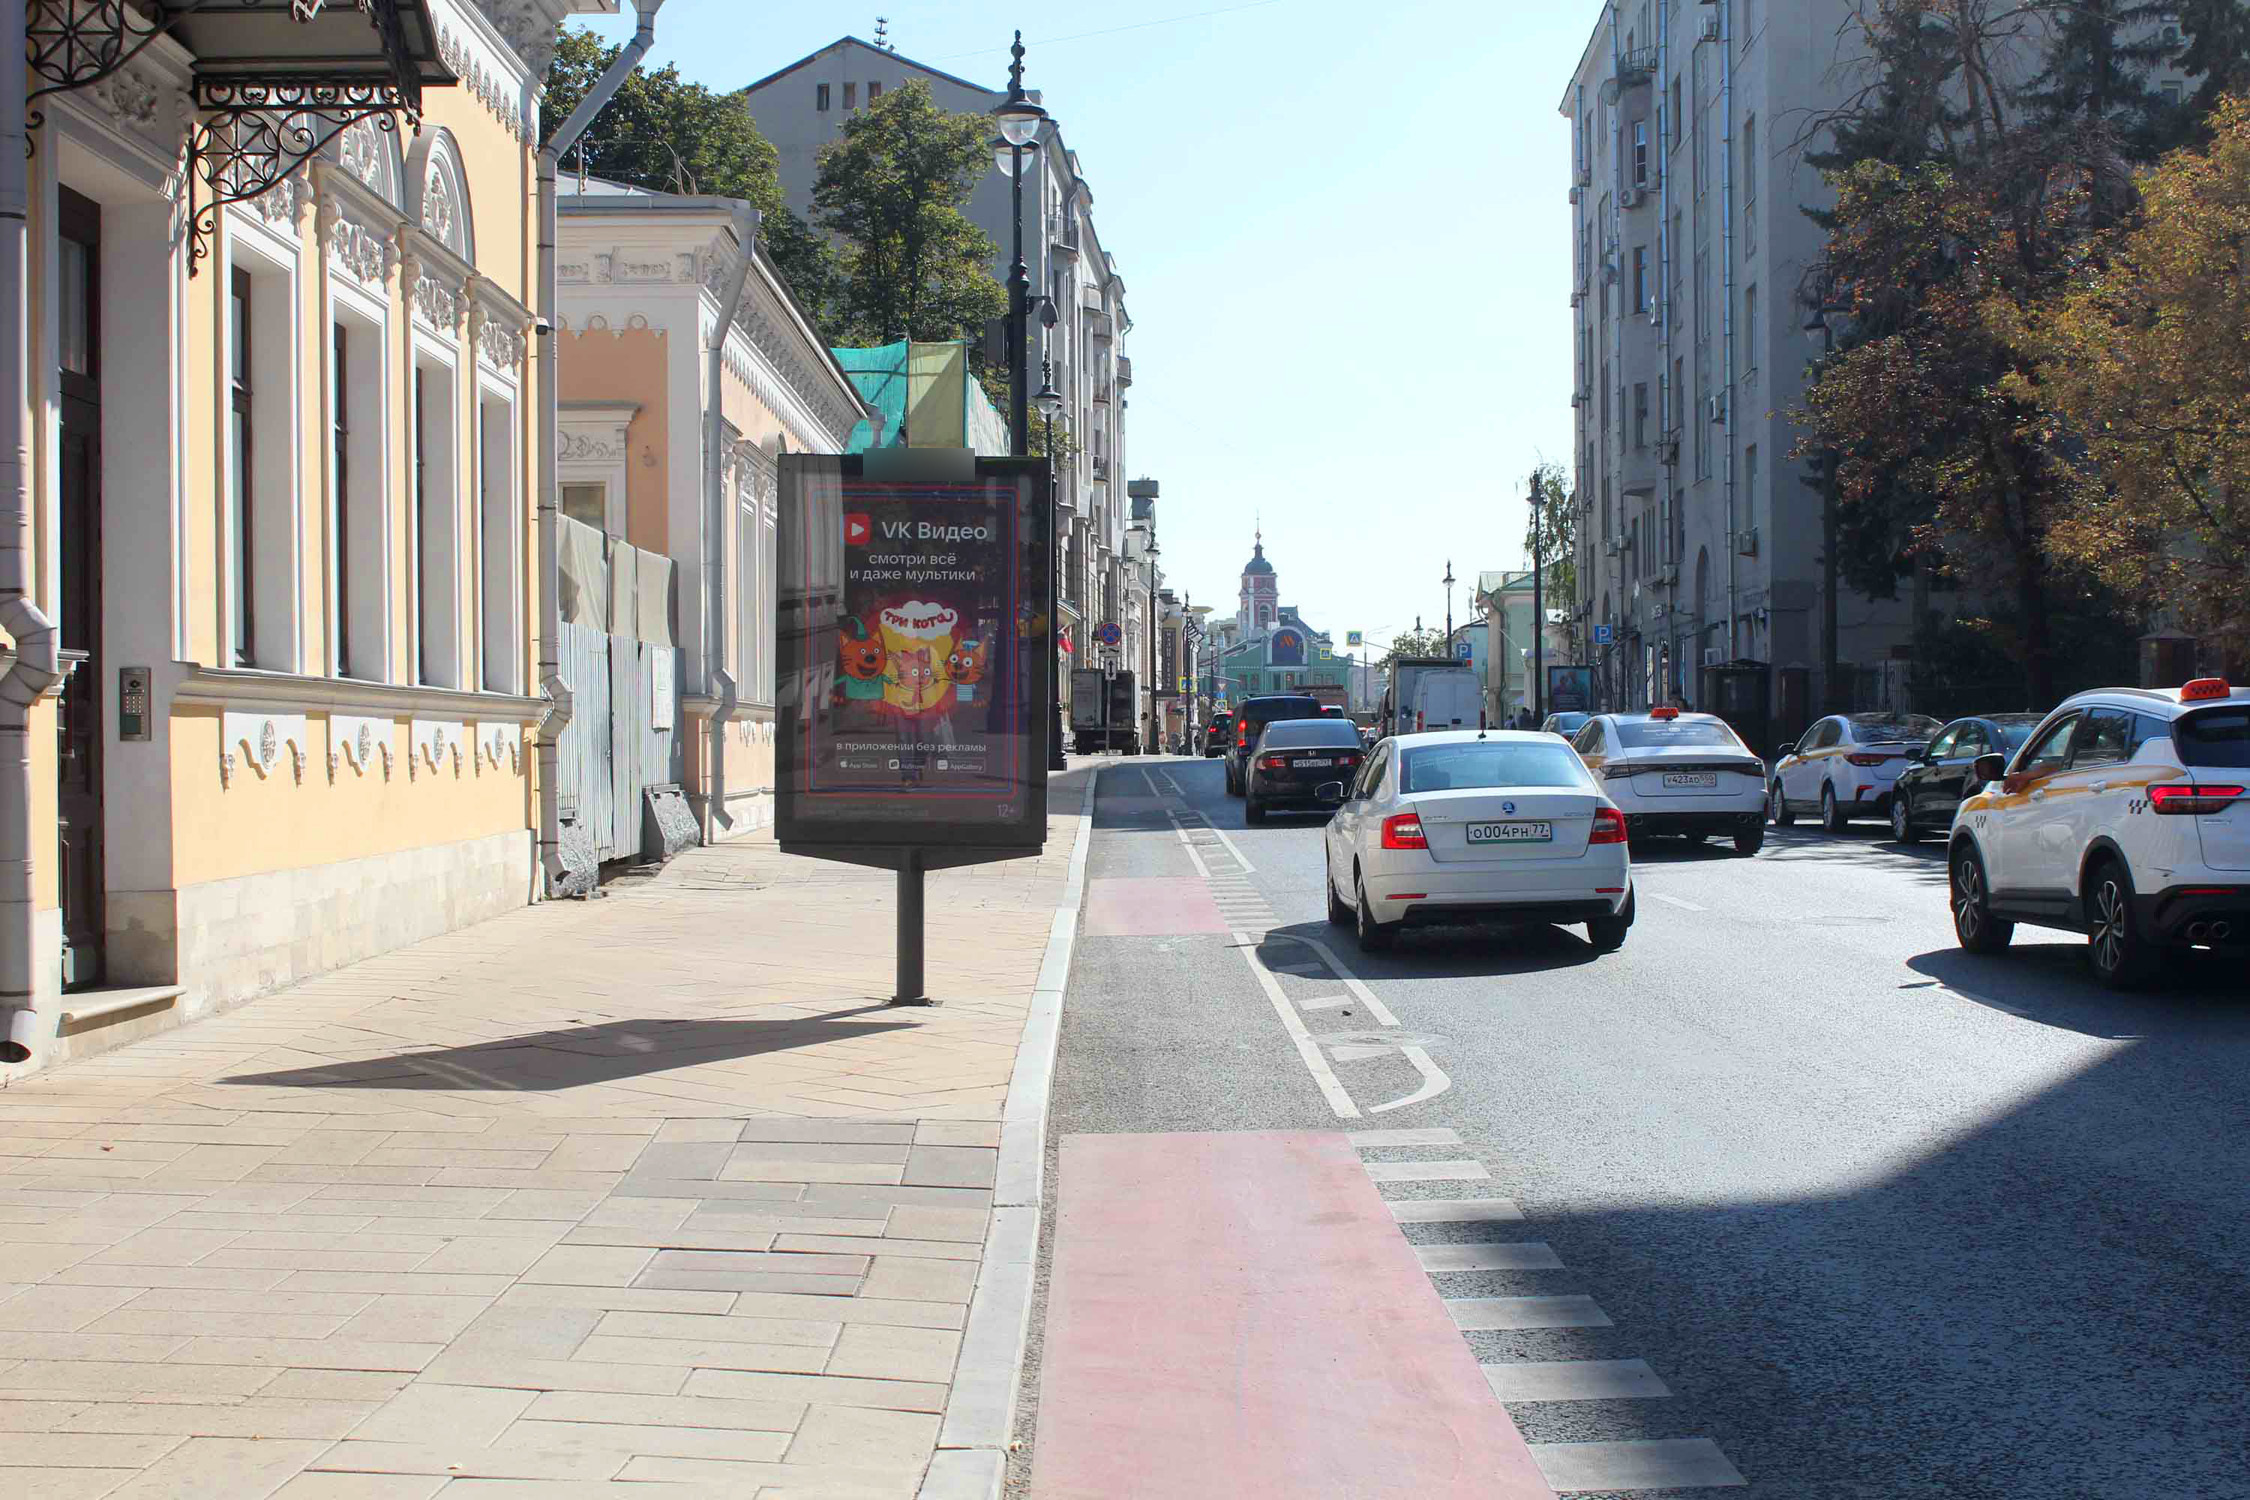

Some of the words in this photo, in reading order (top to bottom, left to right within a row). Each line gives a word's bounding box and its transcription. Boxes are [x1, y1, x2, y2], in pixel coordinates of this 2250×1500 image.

[881, 521, 912, 539] VK
[918, 521, 988, 543] Видео
[868, 554, 926, 567] смотри
[930, 552, 957, 565] всё
[849, 569, 859, 579] и
[862, 569, 902, 581] даже
[905, 570, 976, 583] мультики
[884, 610, 909, 628] ТРИ
[845, 742, 914, 752] приложении
[916, 742, 935, 751] без
[937, 744, 987, 753] рекламы
[996, 803, 1014, 818] 12+
